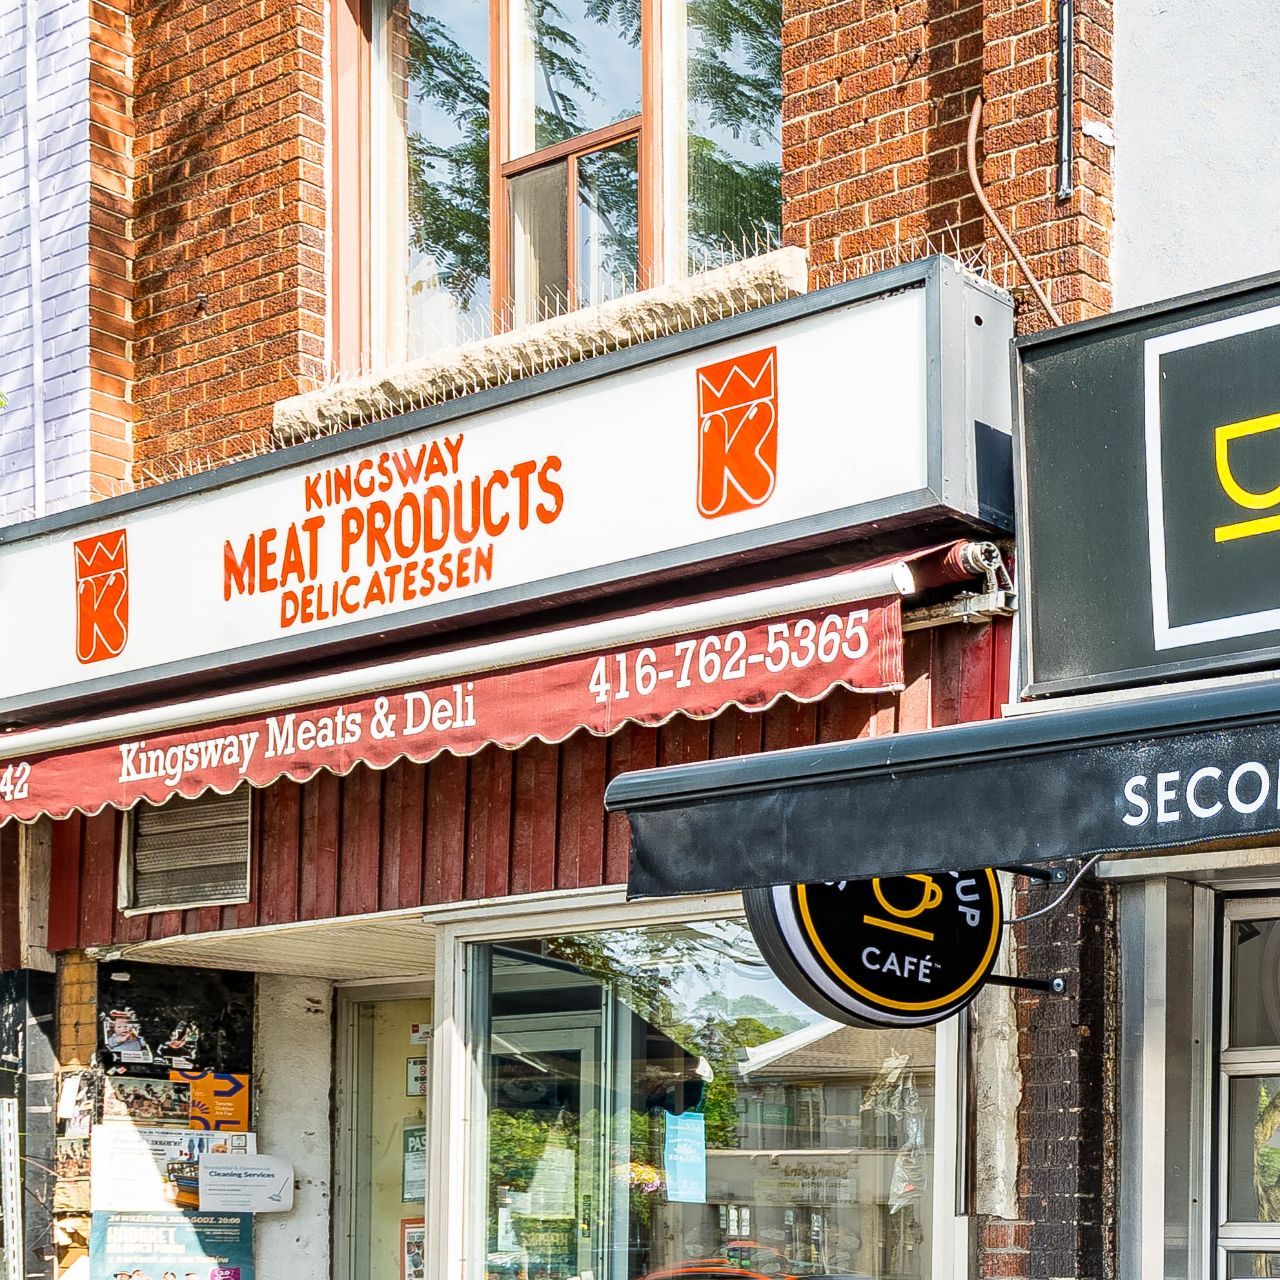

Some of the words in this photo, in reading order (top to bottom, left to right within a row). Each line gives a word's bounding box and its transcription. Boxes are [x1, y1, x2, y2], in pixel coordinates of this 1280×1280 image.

[305, 433, 464, 511] KINGSWAY
[223, 514, 329, 602] MEAT
[340, 455, 565, 573] PRODUCTS
[280, 544, 493, 628] DELICATESSEN
[588, 608, 870, 705] 416-762-5365
[118, 730, 260, 786] Kingsway
[264, 701, 366, 760] Meats
[372, 697, 398, 738] &
[402, 681, 476, 735] Deli
[861, 946, 933, 984] CAFÉ
[208, 1171, 243, 1179] Cleaning
[244, 1171, 275, 1179] Services
